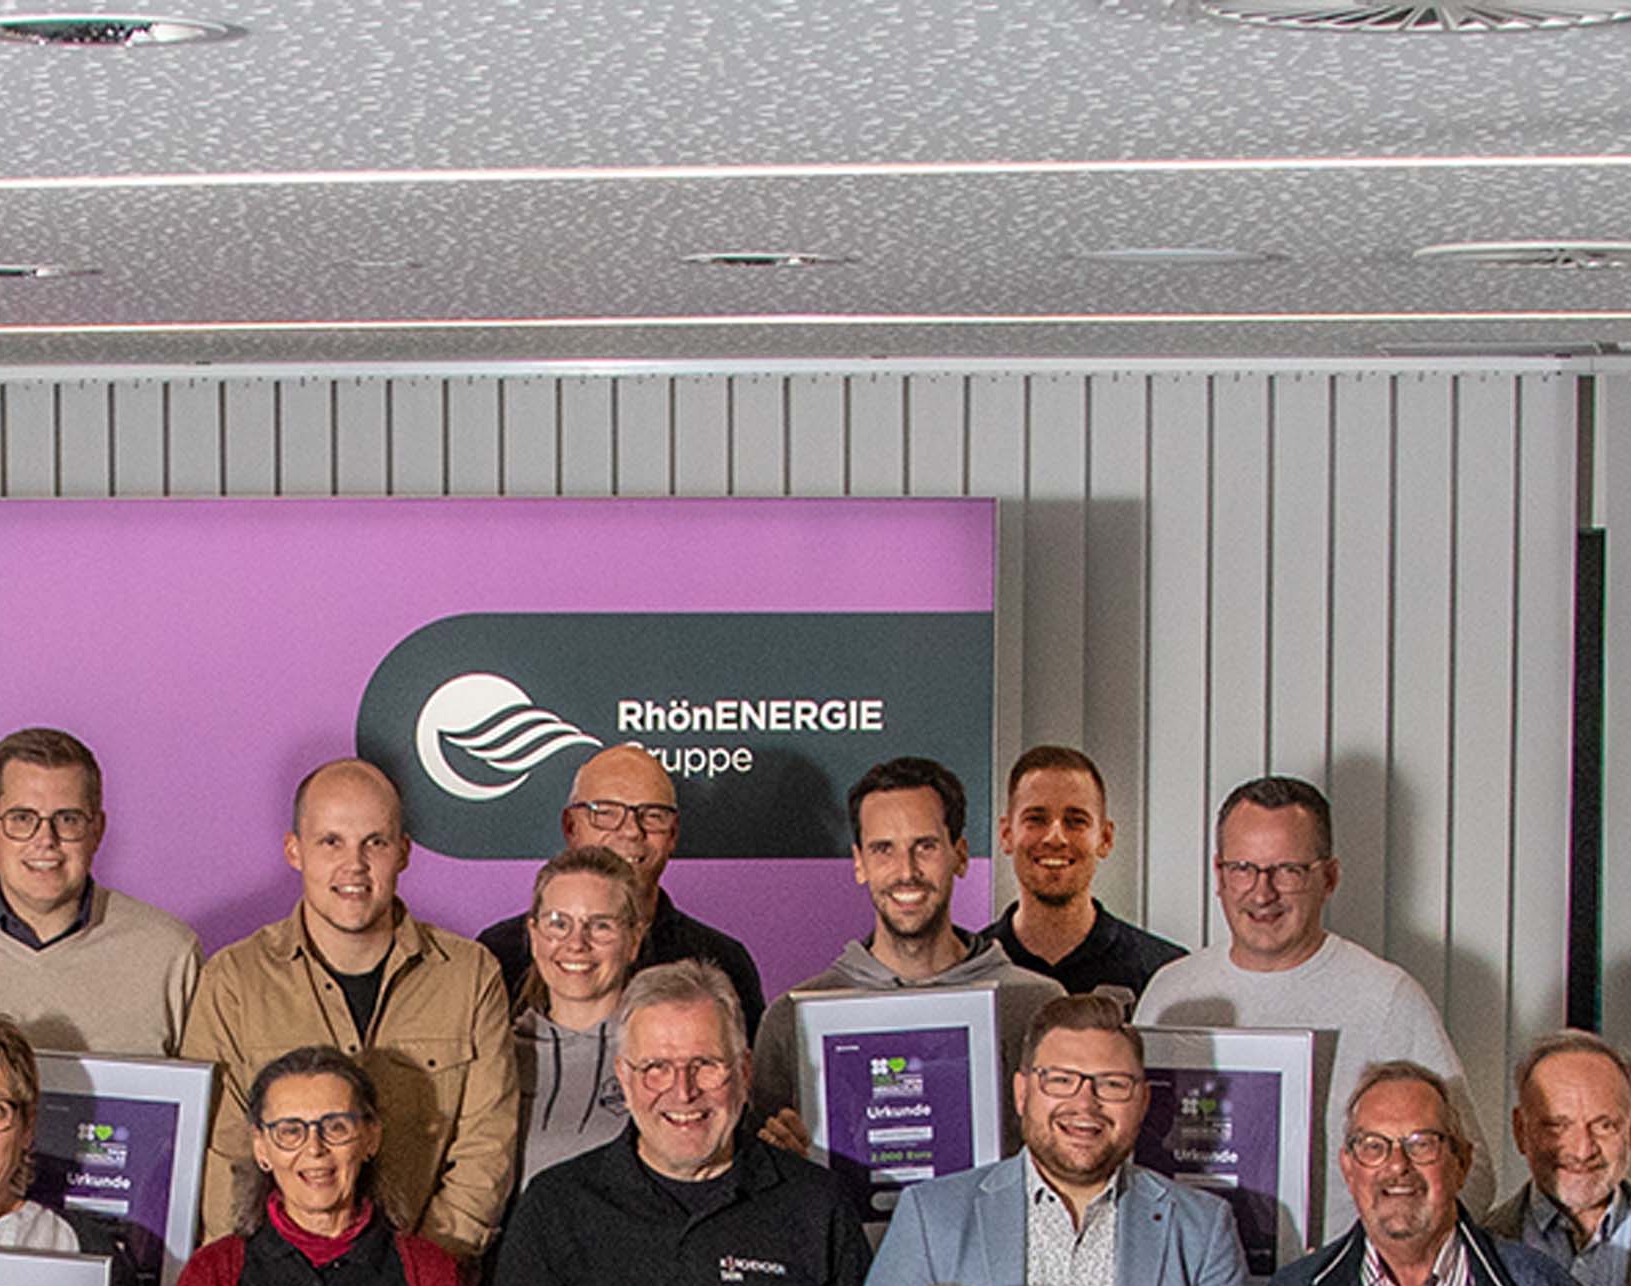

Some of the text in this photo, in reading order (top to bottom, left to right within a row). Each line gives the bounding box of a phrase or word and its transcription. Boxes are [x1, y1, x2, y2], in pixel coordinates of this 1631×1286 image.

[618, 700, 884, 732] RhönENERGIE
[866, 1105, 931, 1119] Urkunde
[1174, 1148, 1238, 1163] Urkunde
[66, 1172, 130, 1189] Urkunde
